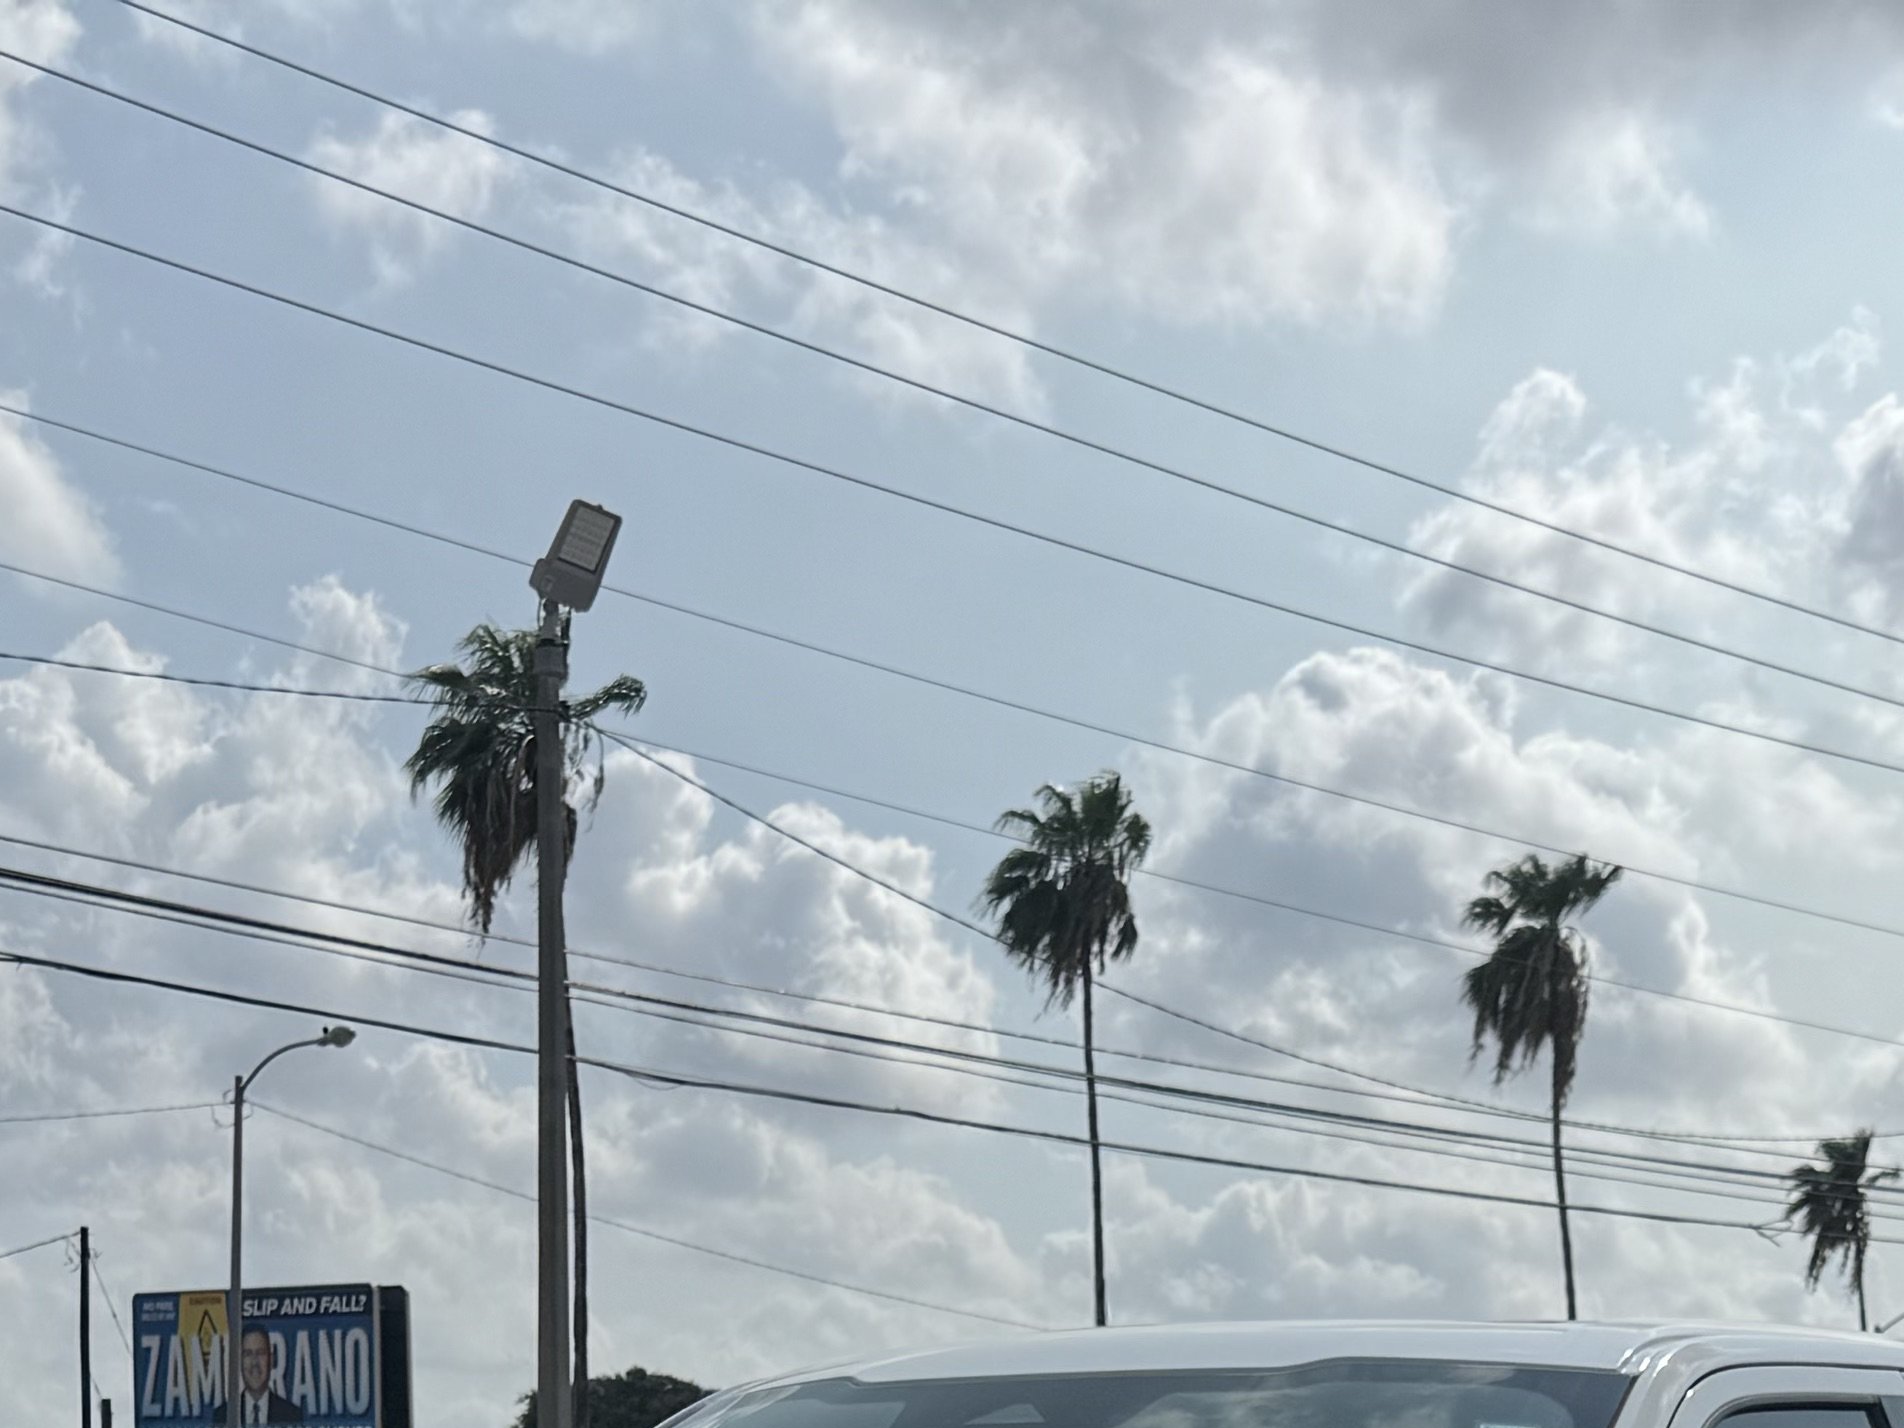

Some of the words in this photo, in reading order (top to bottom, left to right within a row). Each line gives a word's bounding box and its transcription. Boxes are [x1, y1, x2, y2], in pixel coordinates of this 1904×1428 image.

[242, 1299, 278, 1317] SLIP
[280, 1298, 315, 1316] AND
[319, 1295, 368, 1314] FALL?
[141, 1327, 371, 1418] ZAMRANO
